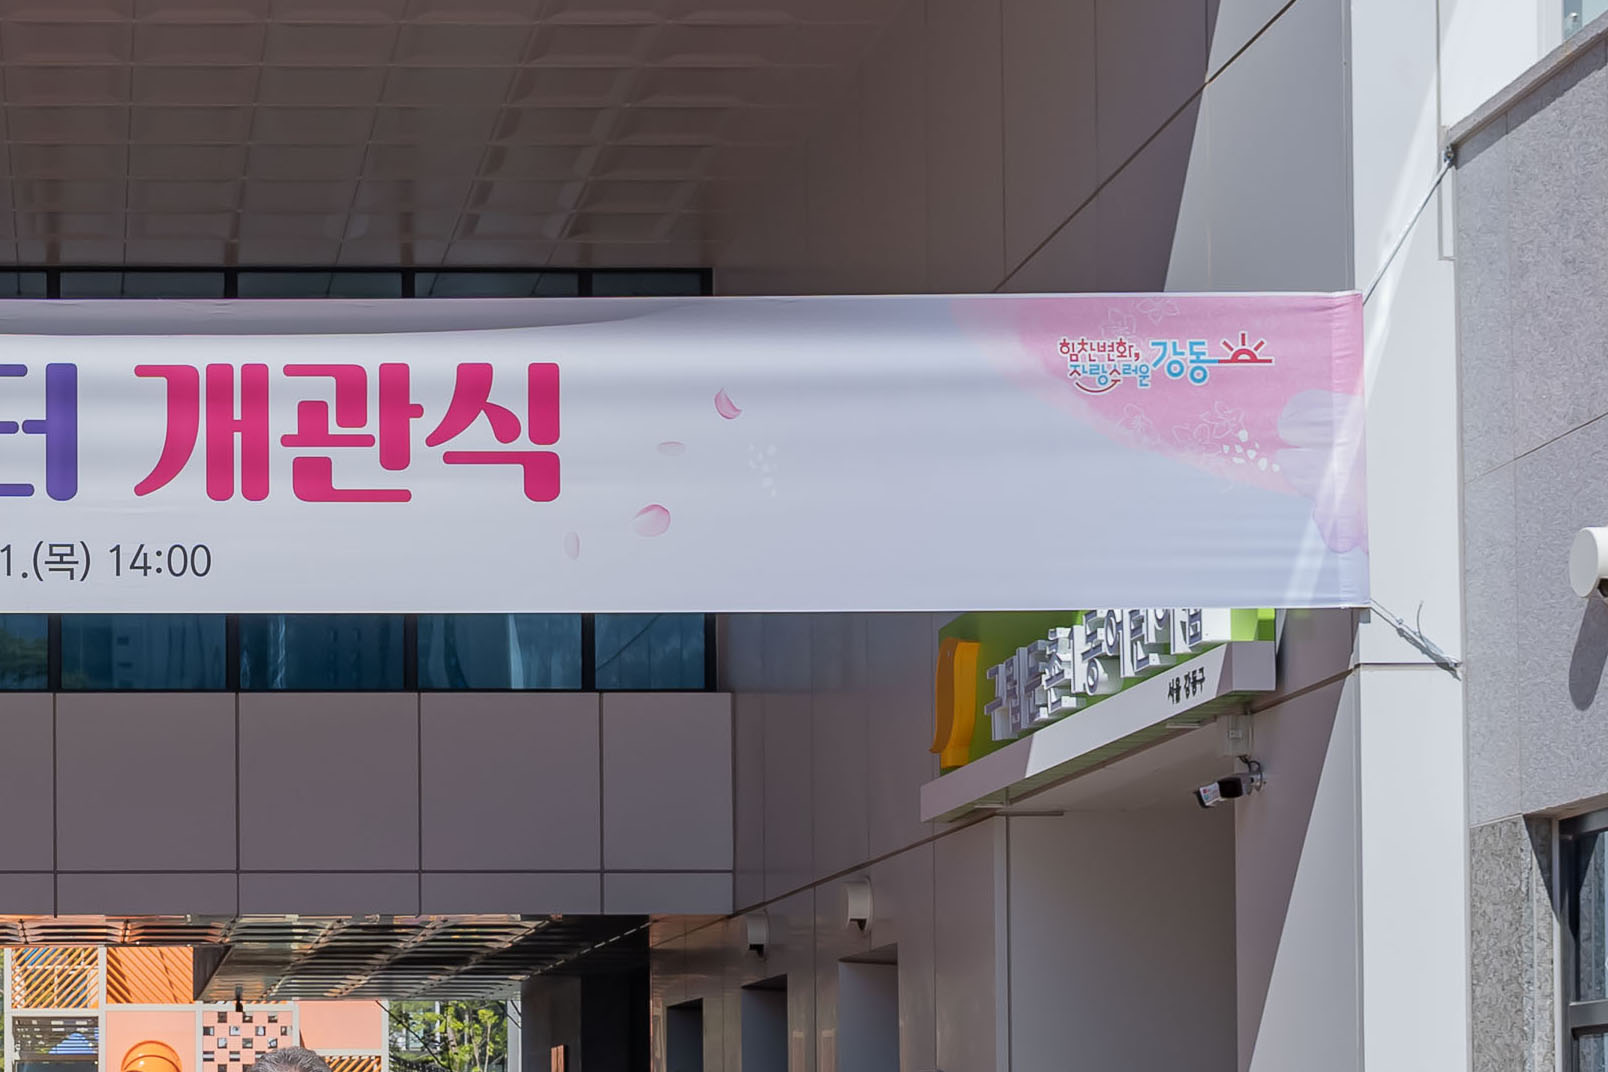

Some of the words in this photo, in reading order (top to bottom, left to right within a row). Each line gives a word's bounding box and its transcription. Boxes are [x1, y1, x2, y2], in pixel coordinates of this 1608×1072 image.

[1069, 363, 1149, 387] 자랑스러운
[1150, 340, 1210, 385] 강동
[133, 361, 562, 504] 개관식
[109, 543, 212, 578] 14:00
